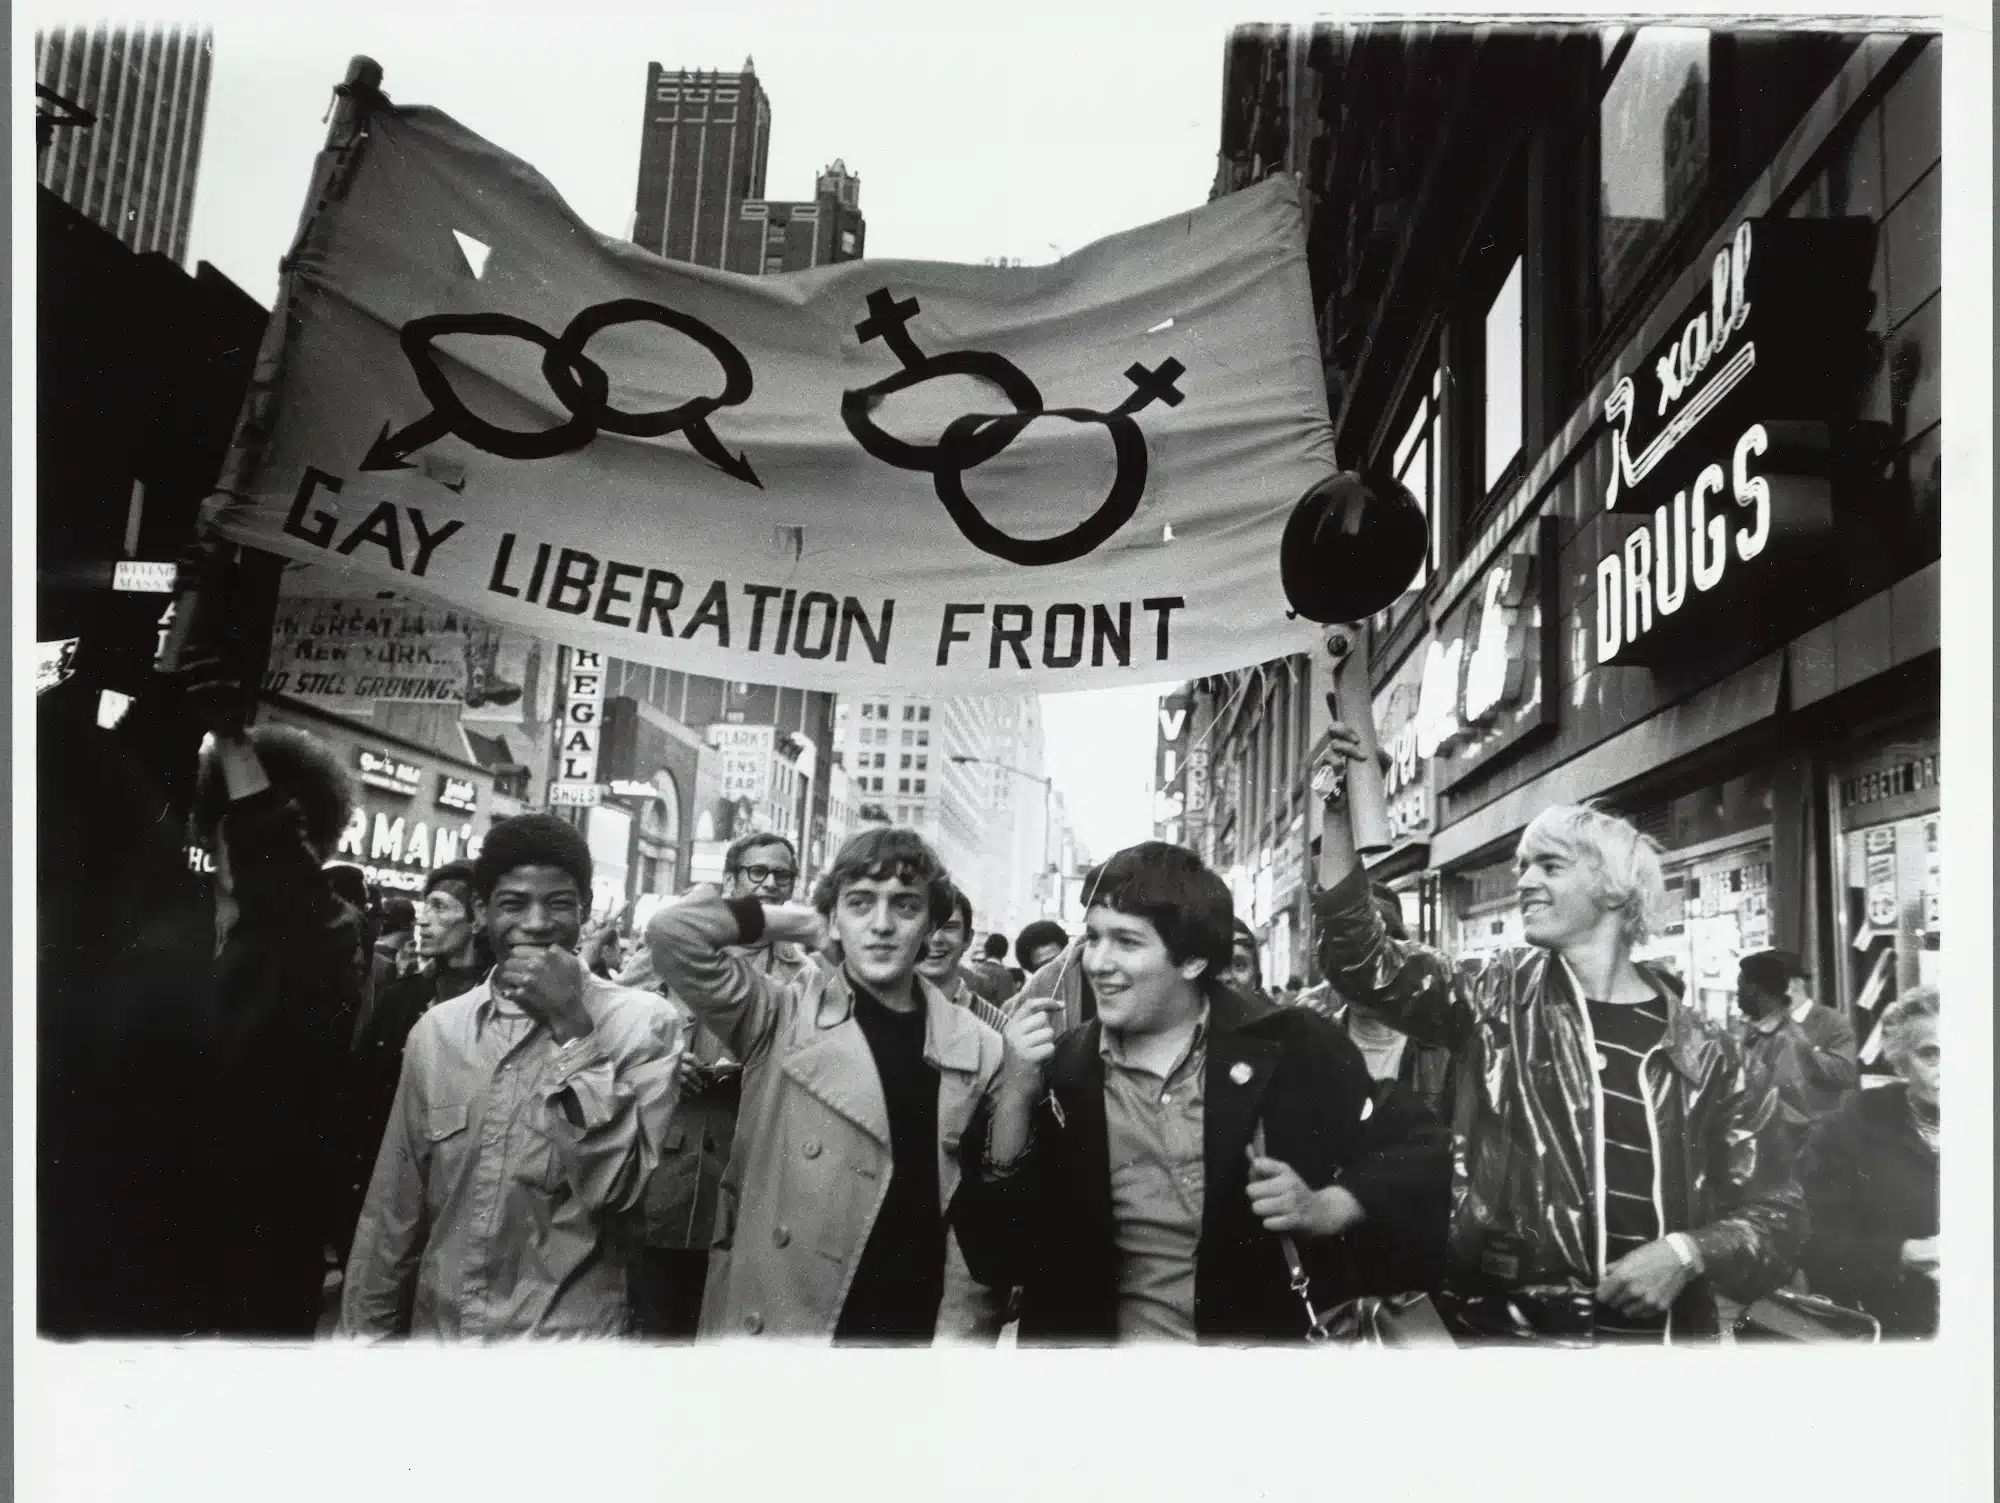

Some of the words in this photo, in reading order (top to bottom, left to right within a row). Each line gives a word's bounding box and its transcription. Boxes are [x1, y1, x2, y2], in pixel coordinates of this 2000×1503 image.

[283, 465, 465, 577] GAY
[488, 532, 895, 665] LIBERATION
[935, 596, 1185, 670] FRONT
[1597, 423, 1770, 664] DRUGS
[294, 672, 346, 695] STILL
[564, 649, 600, 779] REGAL
